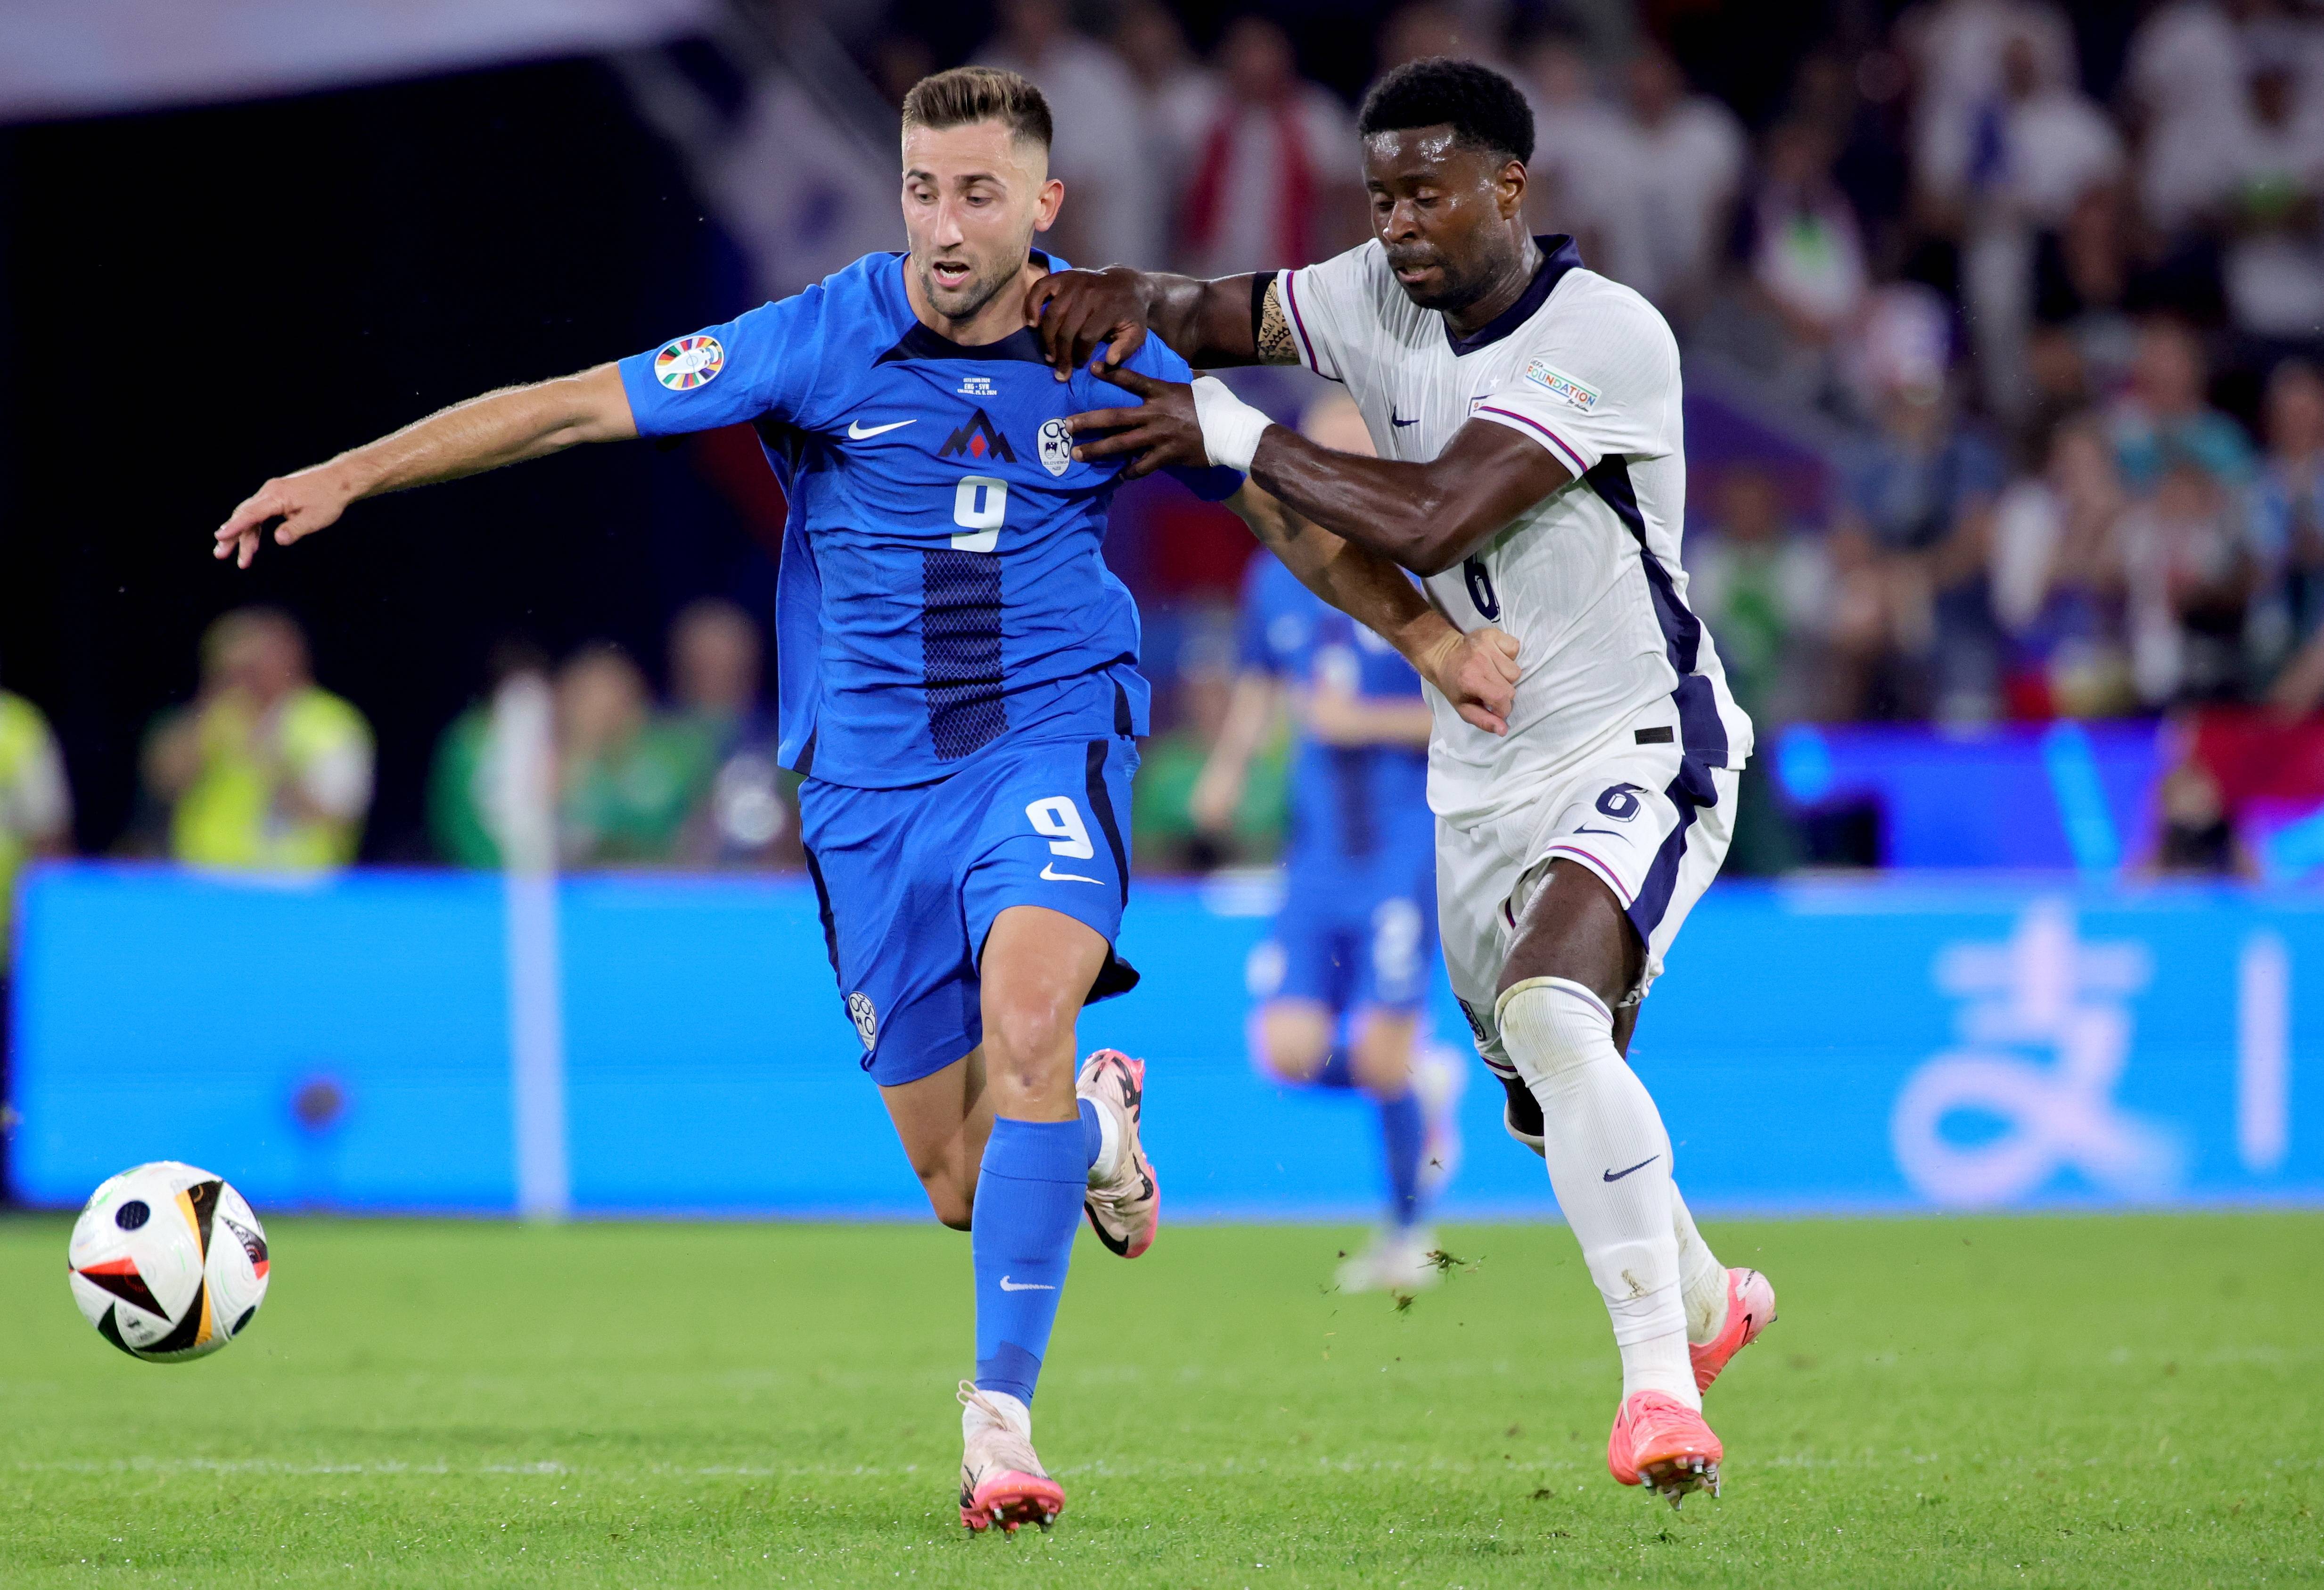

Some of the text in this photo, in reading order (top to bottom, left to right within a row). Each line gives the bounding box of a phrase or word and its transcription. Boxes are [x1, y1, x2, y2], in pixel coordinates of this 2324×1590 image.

[951, 475, 1008, 552] 9
[1463, 552, 1501, 623] 6
[1025, 795, 1094, 860] 9
[1595, 782, 1649, 823] 6
